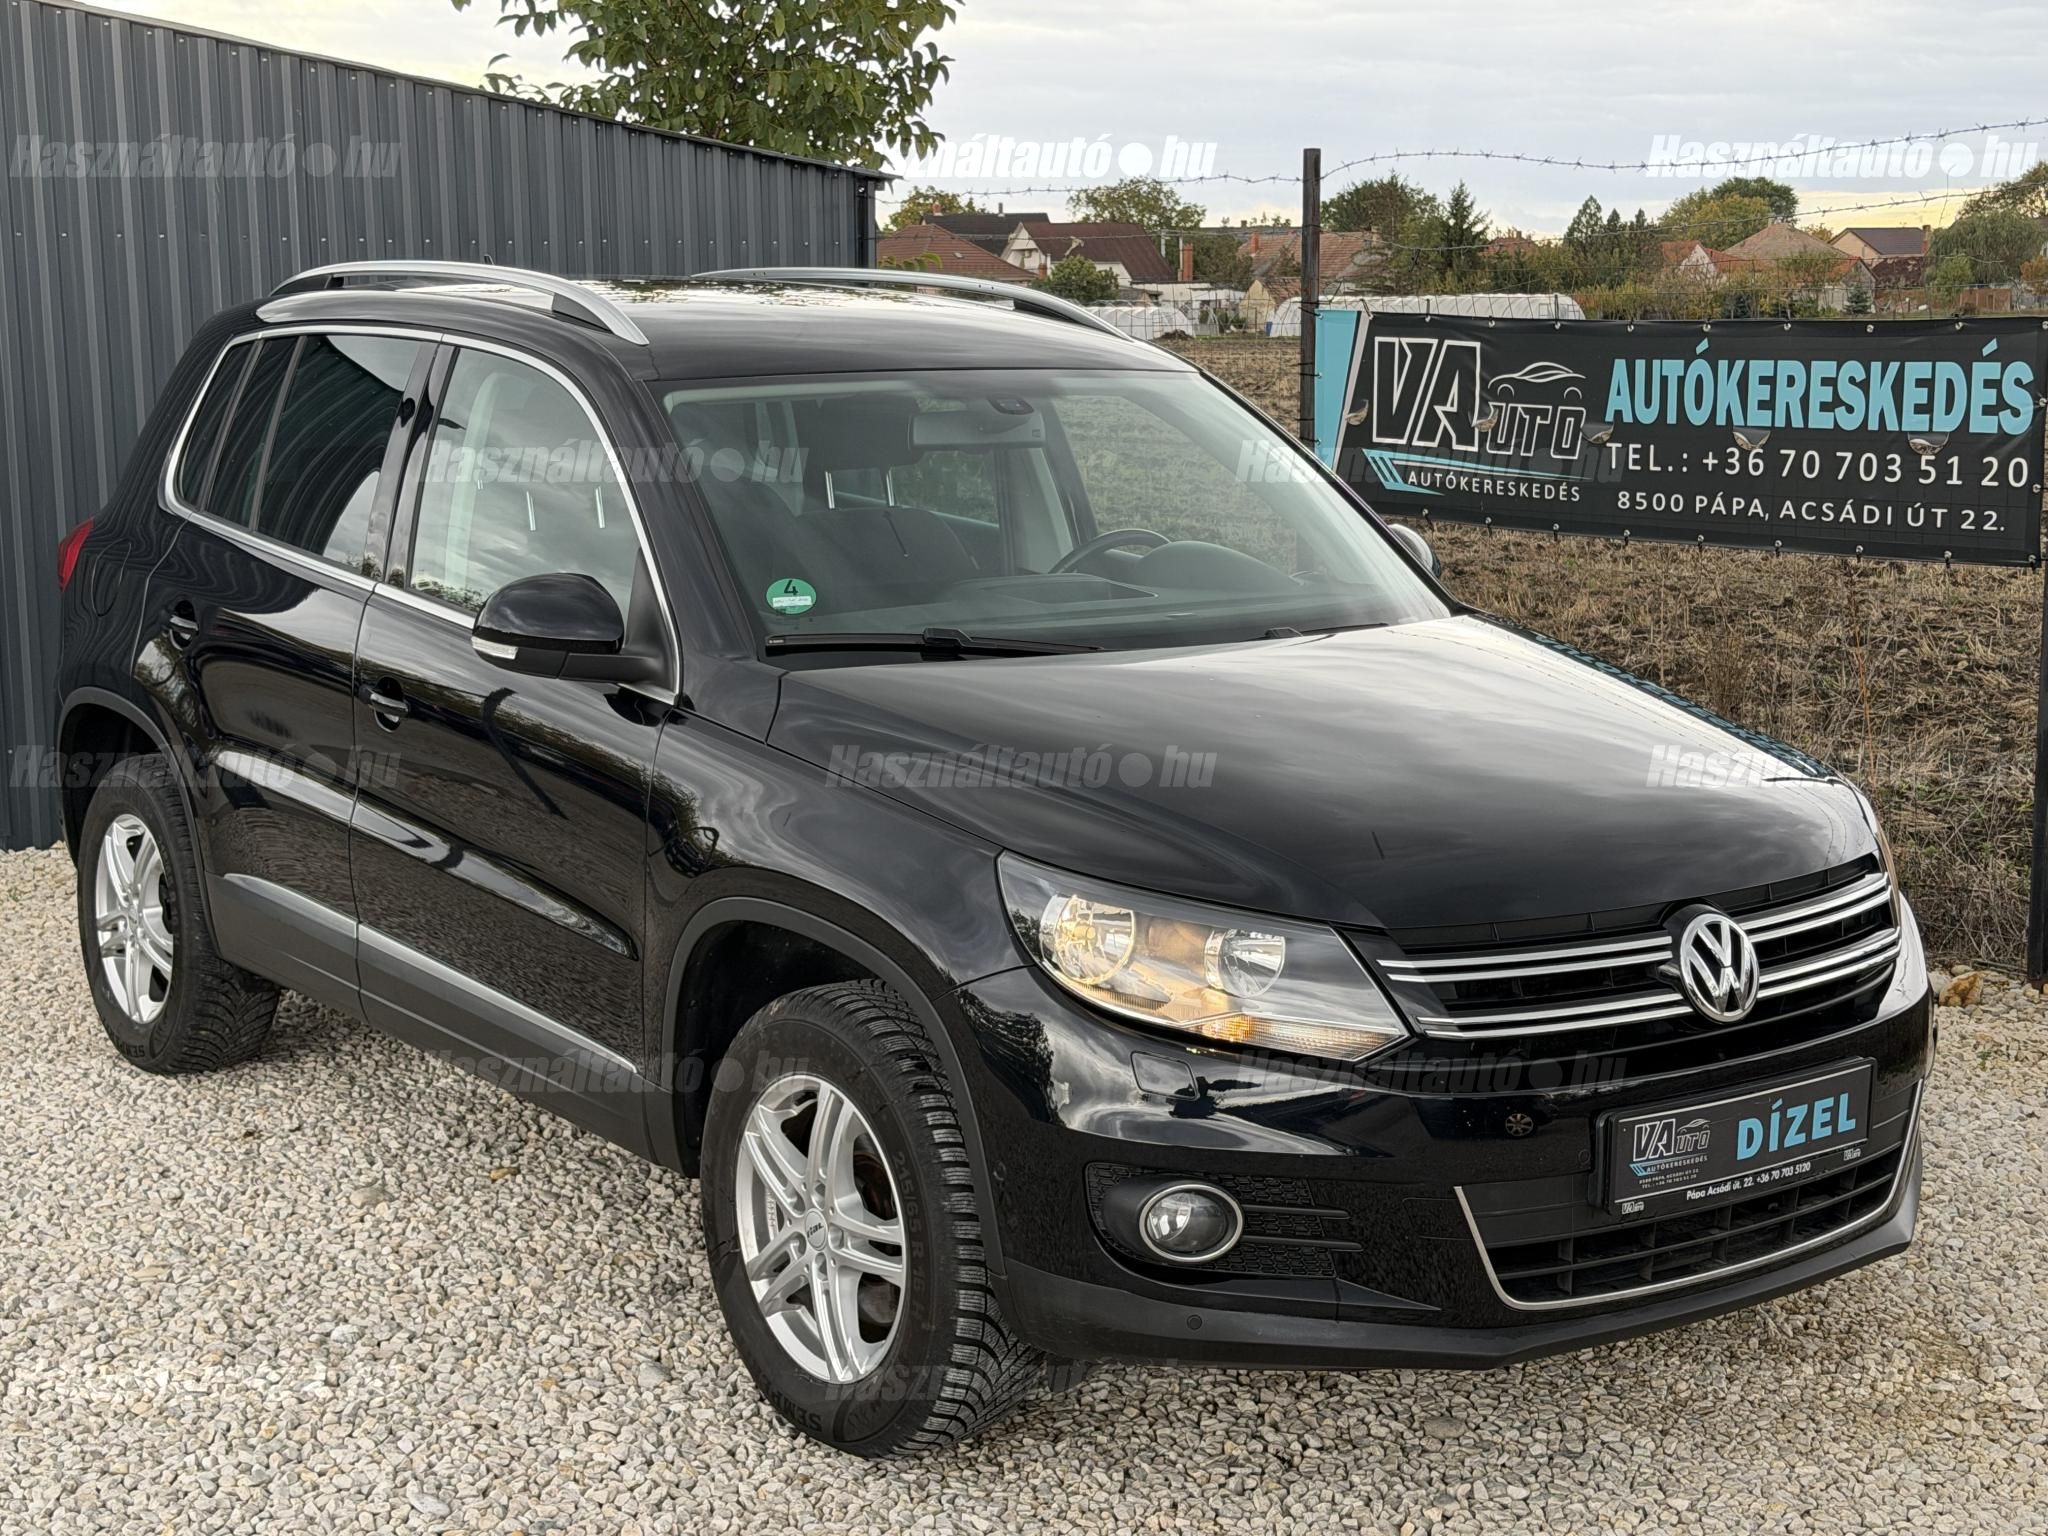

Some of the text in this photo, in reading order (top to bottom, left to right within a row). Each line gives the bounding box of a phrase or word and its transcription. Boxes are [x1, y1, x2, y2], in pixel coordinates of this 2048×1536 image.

[1605, 337, 2034, 436] AUTÓKERESKEDÉS
[1606, 443, 2028, 488] TEL.: +36 70 703 51 20
[1408, 471, 1580, 501] AUTÓKERESKEDÉS
[1617, 491, 2005, 531] 8500 PÁPA, ACSÁDI ÚT 22.
[784, 579, 798, 595] 4
[1737, 1092, 1856, 1160] DÍZEL
[1686, 1188, 1706, 1200] Pápa
